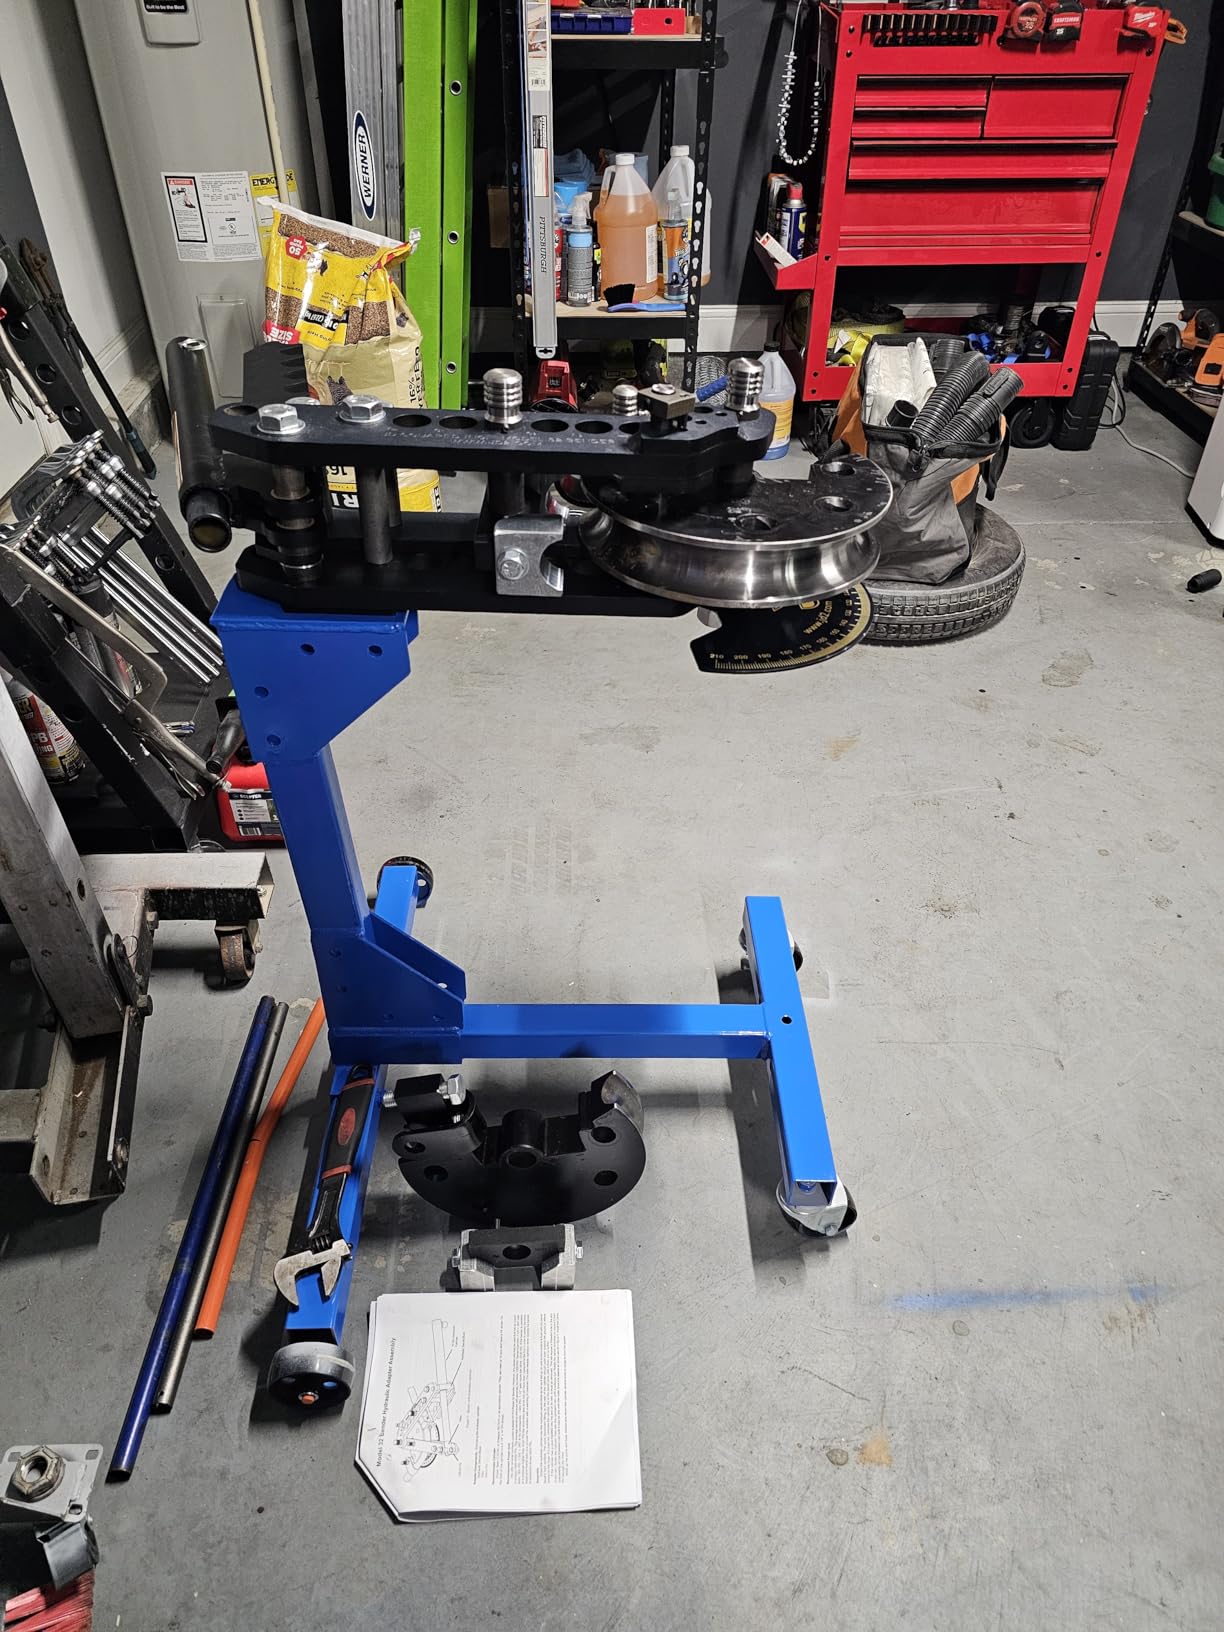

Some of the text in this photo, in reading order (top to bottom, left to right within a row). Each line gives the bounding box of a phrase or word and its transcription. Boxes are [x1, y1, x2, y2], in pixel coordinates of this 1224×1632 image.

[358, 134, 372, 198] WERNER
[288, 245, 301, 255] 50
[539, 216, 547, 273] PITTSBURGH
[269, 326, 294, 341] SIZE
[408, 377, 416, 403] 16%
[331, 493, 360, 508] RI
[31, 732, 49, 743] PB
[388, 1337, 397, 1365] Assembly
[385, 1366, 393, 1388] Adapter
[382, 1389, 391, 1415] Hydraulic
[375, 1447, 383, 1467] Model
